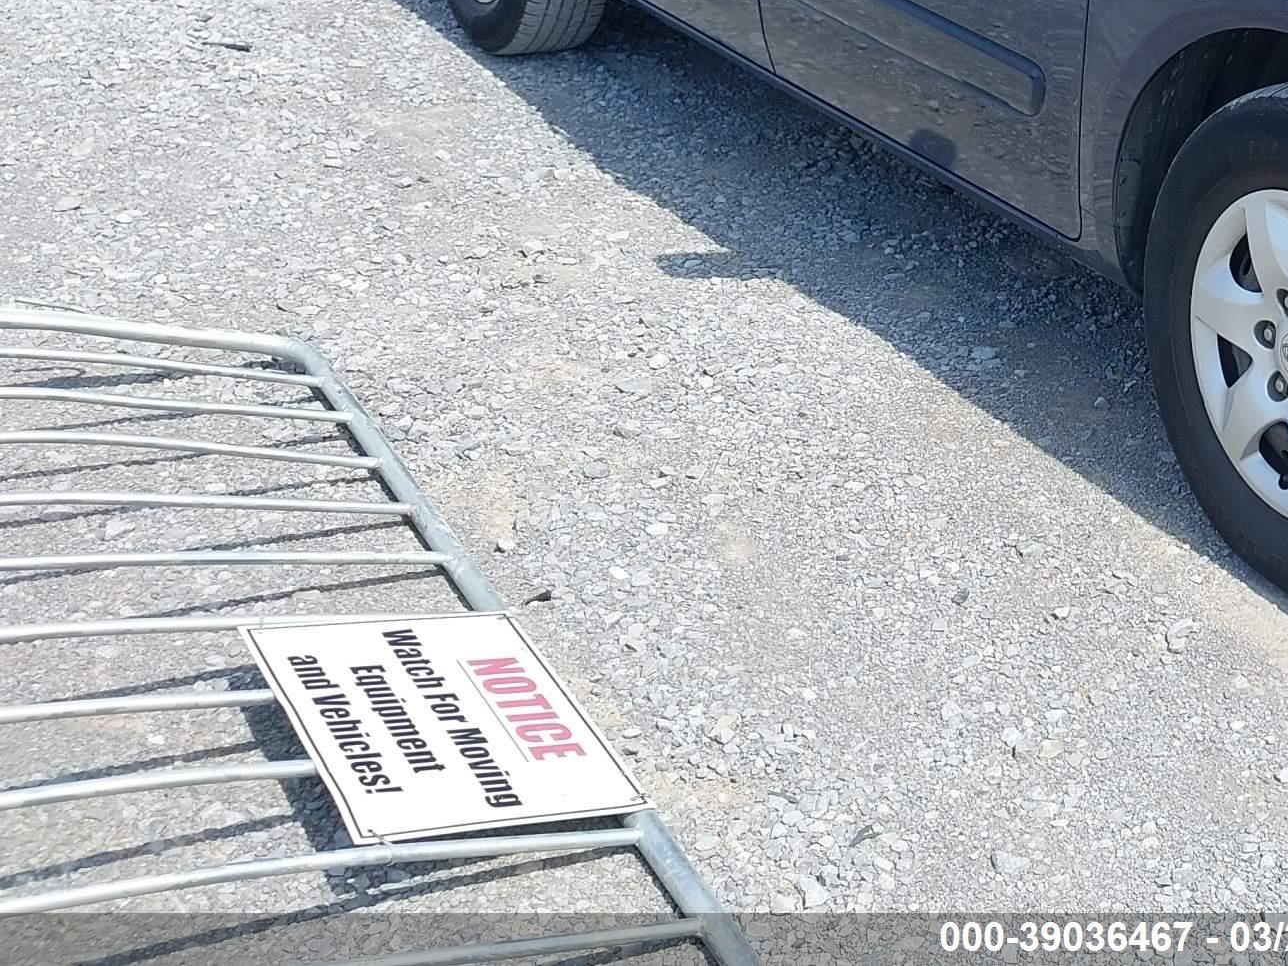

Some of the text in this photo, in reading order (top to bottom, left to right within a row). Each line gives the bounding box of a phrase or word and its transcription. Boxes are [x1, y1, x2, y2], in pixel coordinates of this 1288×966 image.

[287, 654, 405, 795] and Vehicles!
[350, 664, 447, 774] Equipment
[381, 628, 523, 808] Watch For Moving
[466, 657, 588, 761] NOTICE
